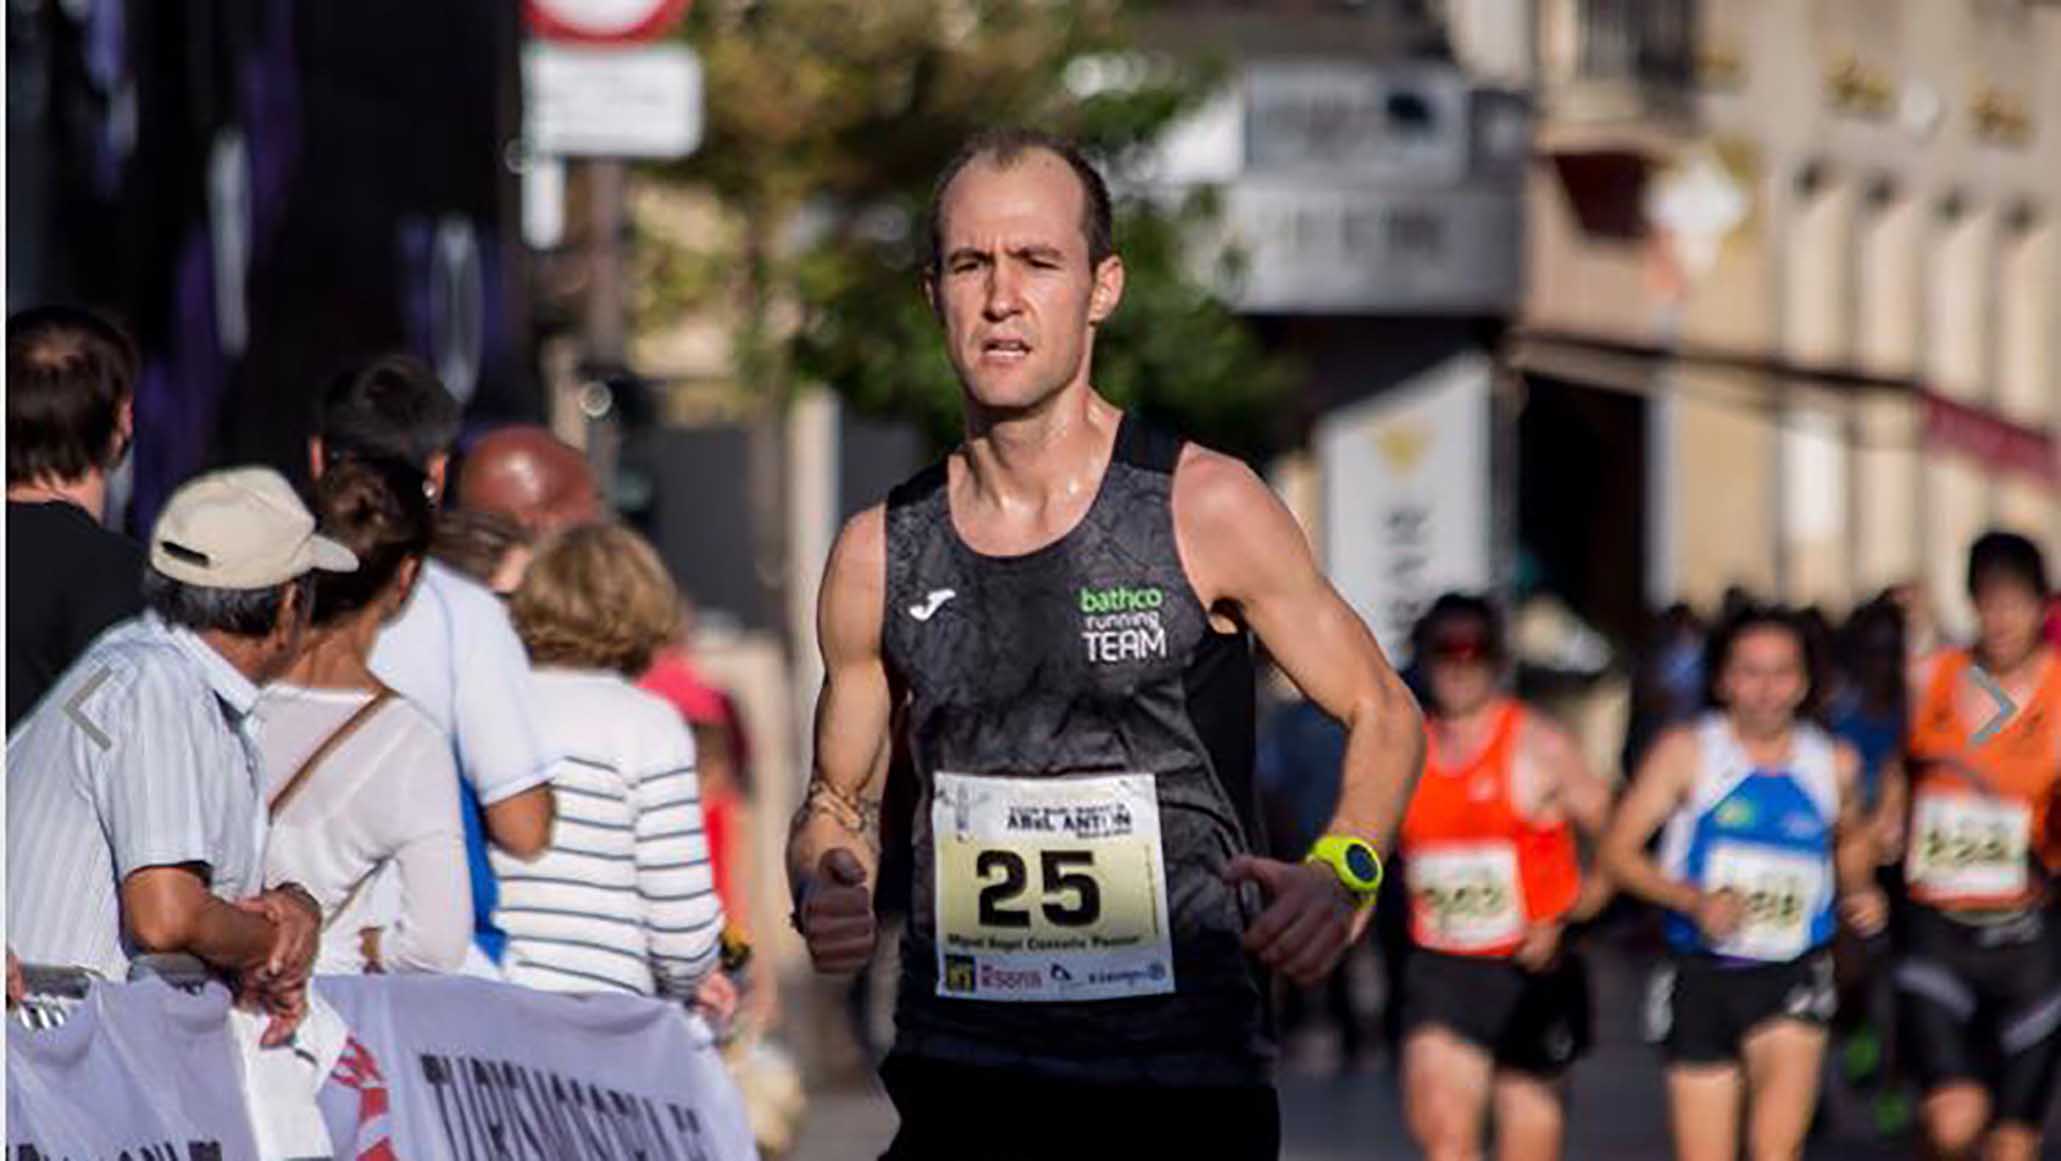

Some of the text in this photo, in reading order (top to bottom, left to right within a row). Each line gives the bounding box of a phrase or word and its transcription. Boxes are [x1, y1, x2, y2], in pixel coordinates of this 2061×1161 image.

[1081, 587, 1162, 612] bathco
[1086, 611, 1160, 630] running
[1081, 627, 1166, 661] TEAM
[976, 850, 1100, 928] 25
